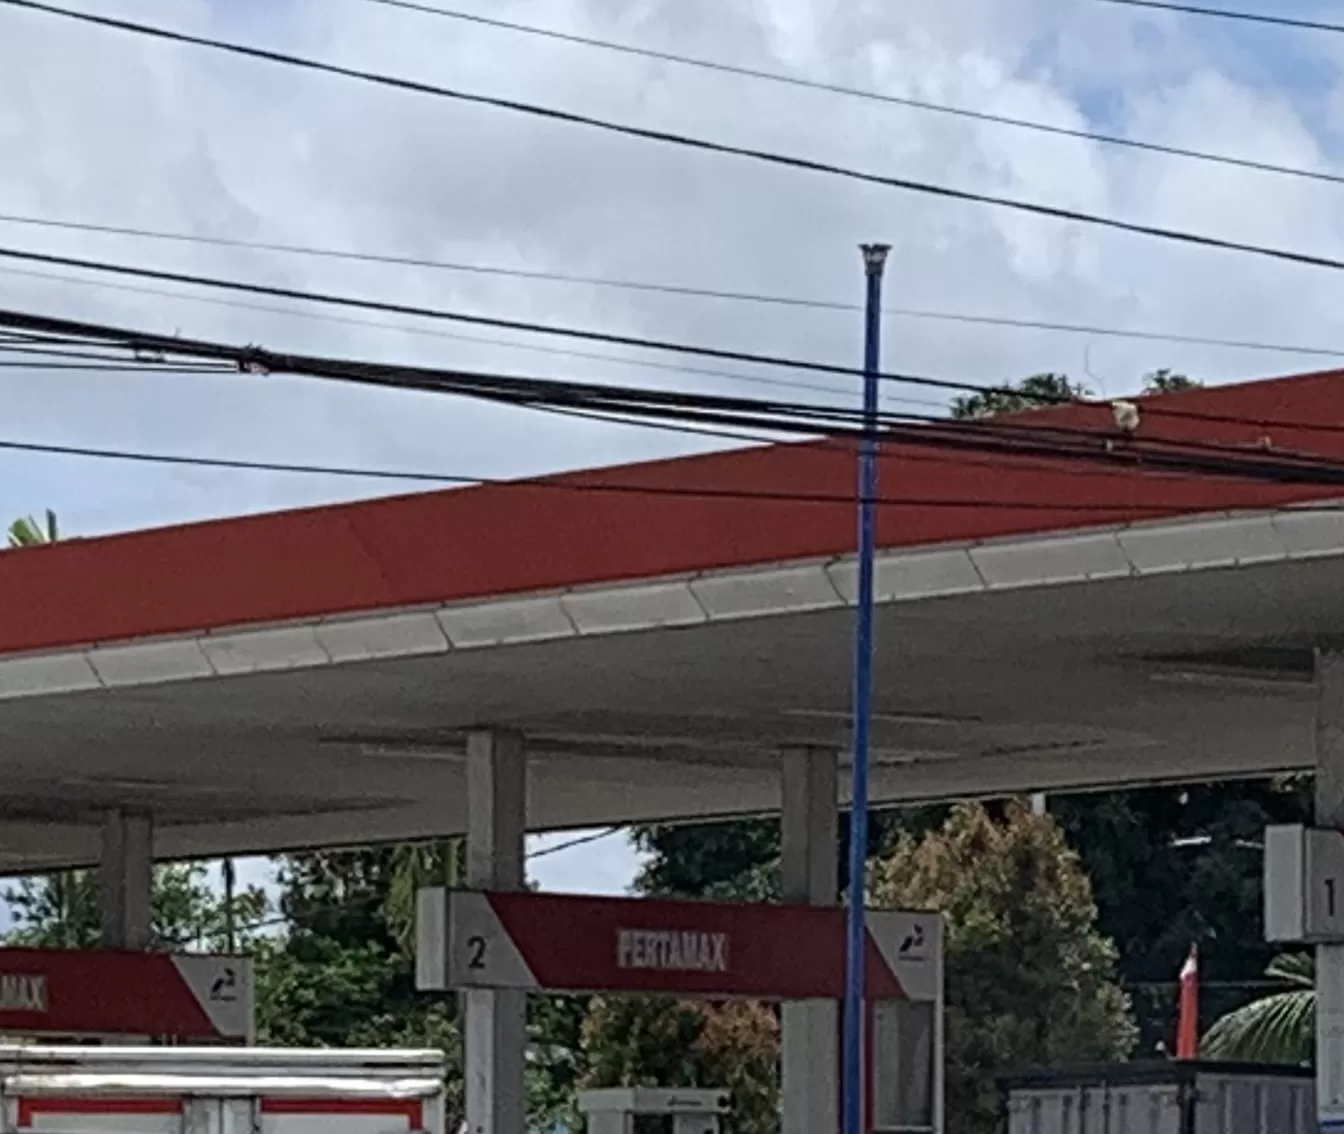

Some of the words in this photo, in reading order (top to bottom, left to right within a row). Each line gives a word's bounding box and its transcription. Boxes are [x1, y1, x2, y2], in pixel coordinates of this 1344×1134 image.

[1324, 878, 1335, 917] 1
[468, 935, 486, 969] 2
[617, 929, 726, 971] PERTAMAX
